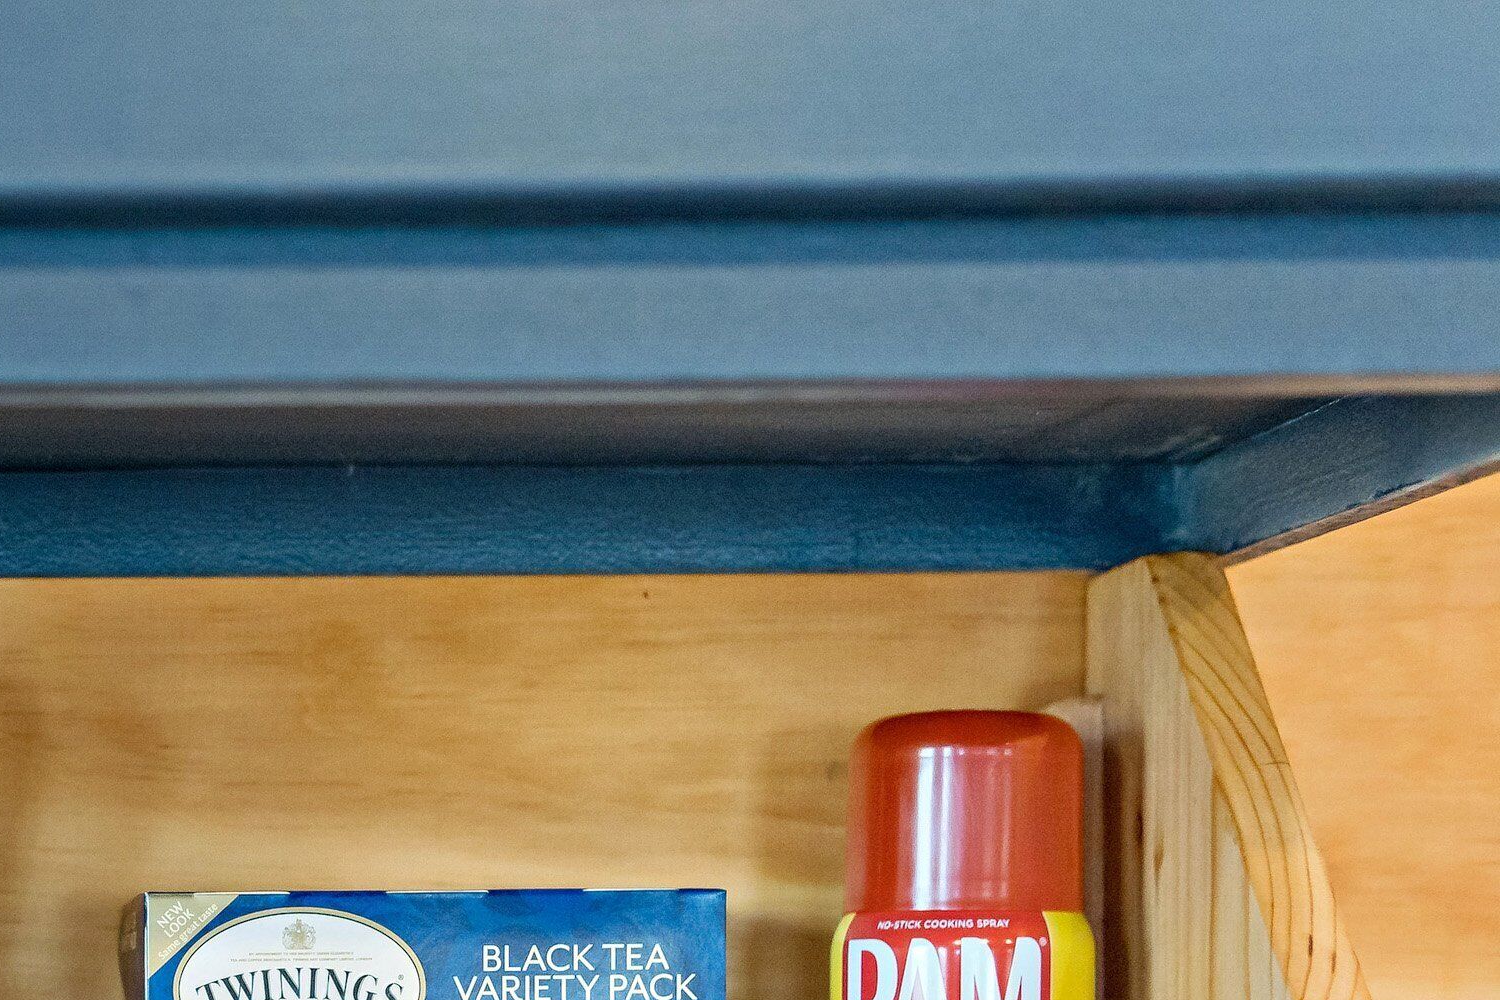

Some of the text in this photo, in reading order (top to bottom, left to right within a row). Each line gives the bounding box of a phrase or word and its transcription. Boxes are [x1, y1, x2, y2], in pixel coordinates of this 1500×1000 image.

[156, 900, 185, 929] NEW
[163, 909, 195, 938] LOOK
[877, 918, 1011, 930] NO-STICK COOKING SPRAY
[158, 903, 218, 960] Same great taste
[481, 942, 671, 972] BLACK TEA
